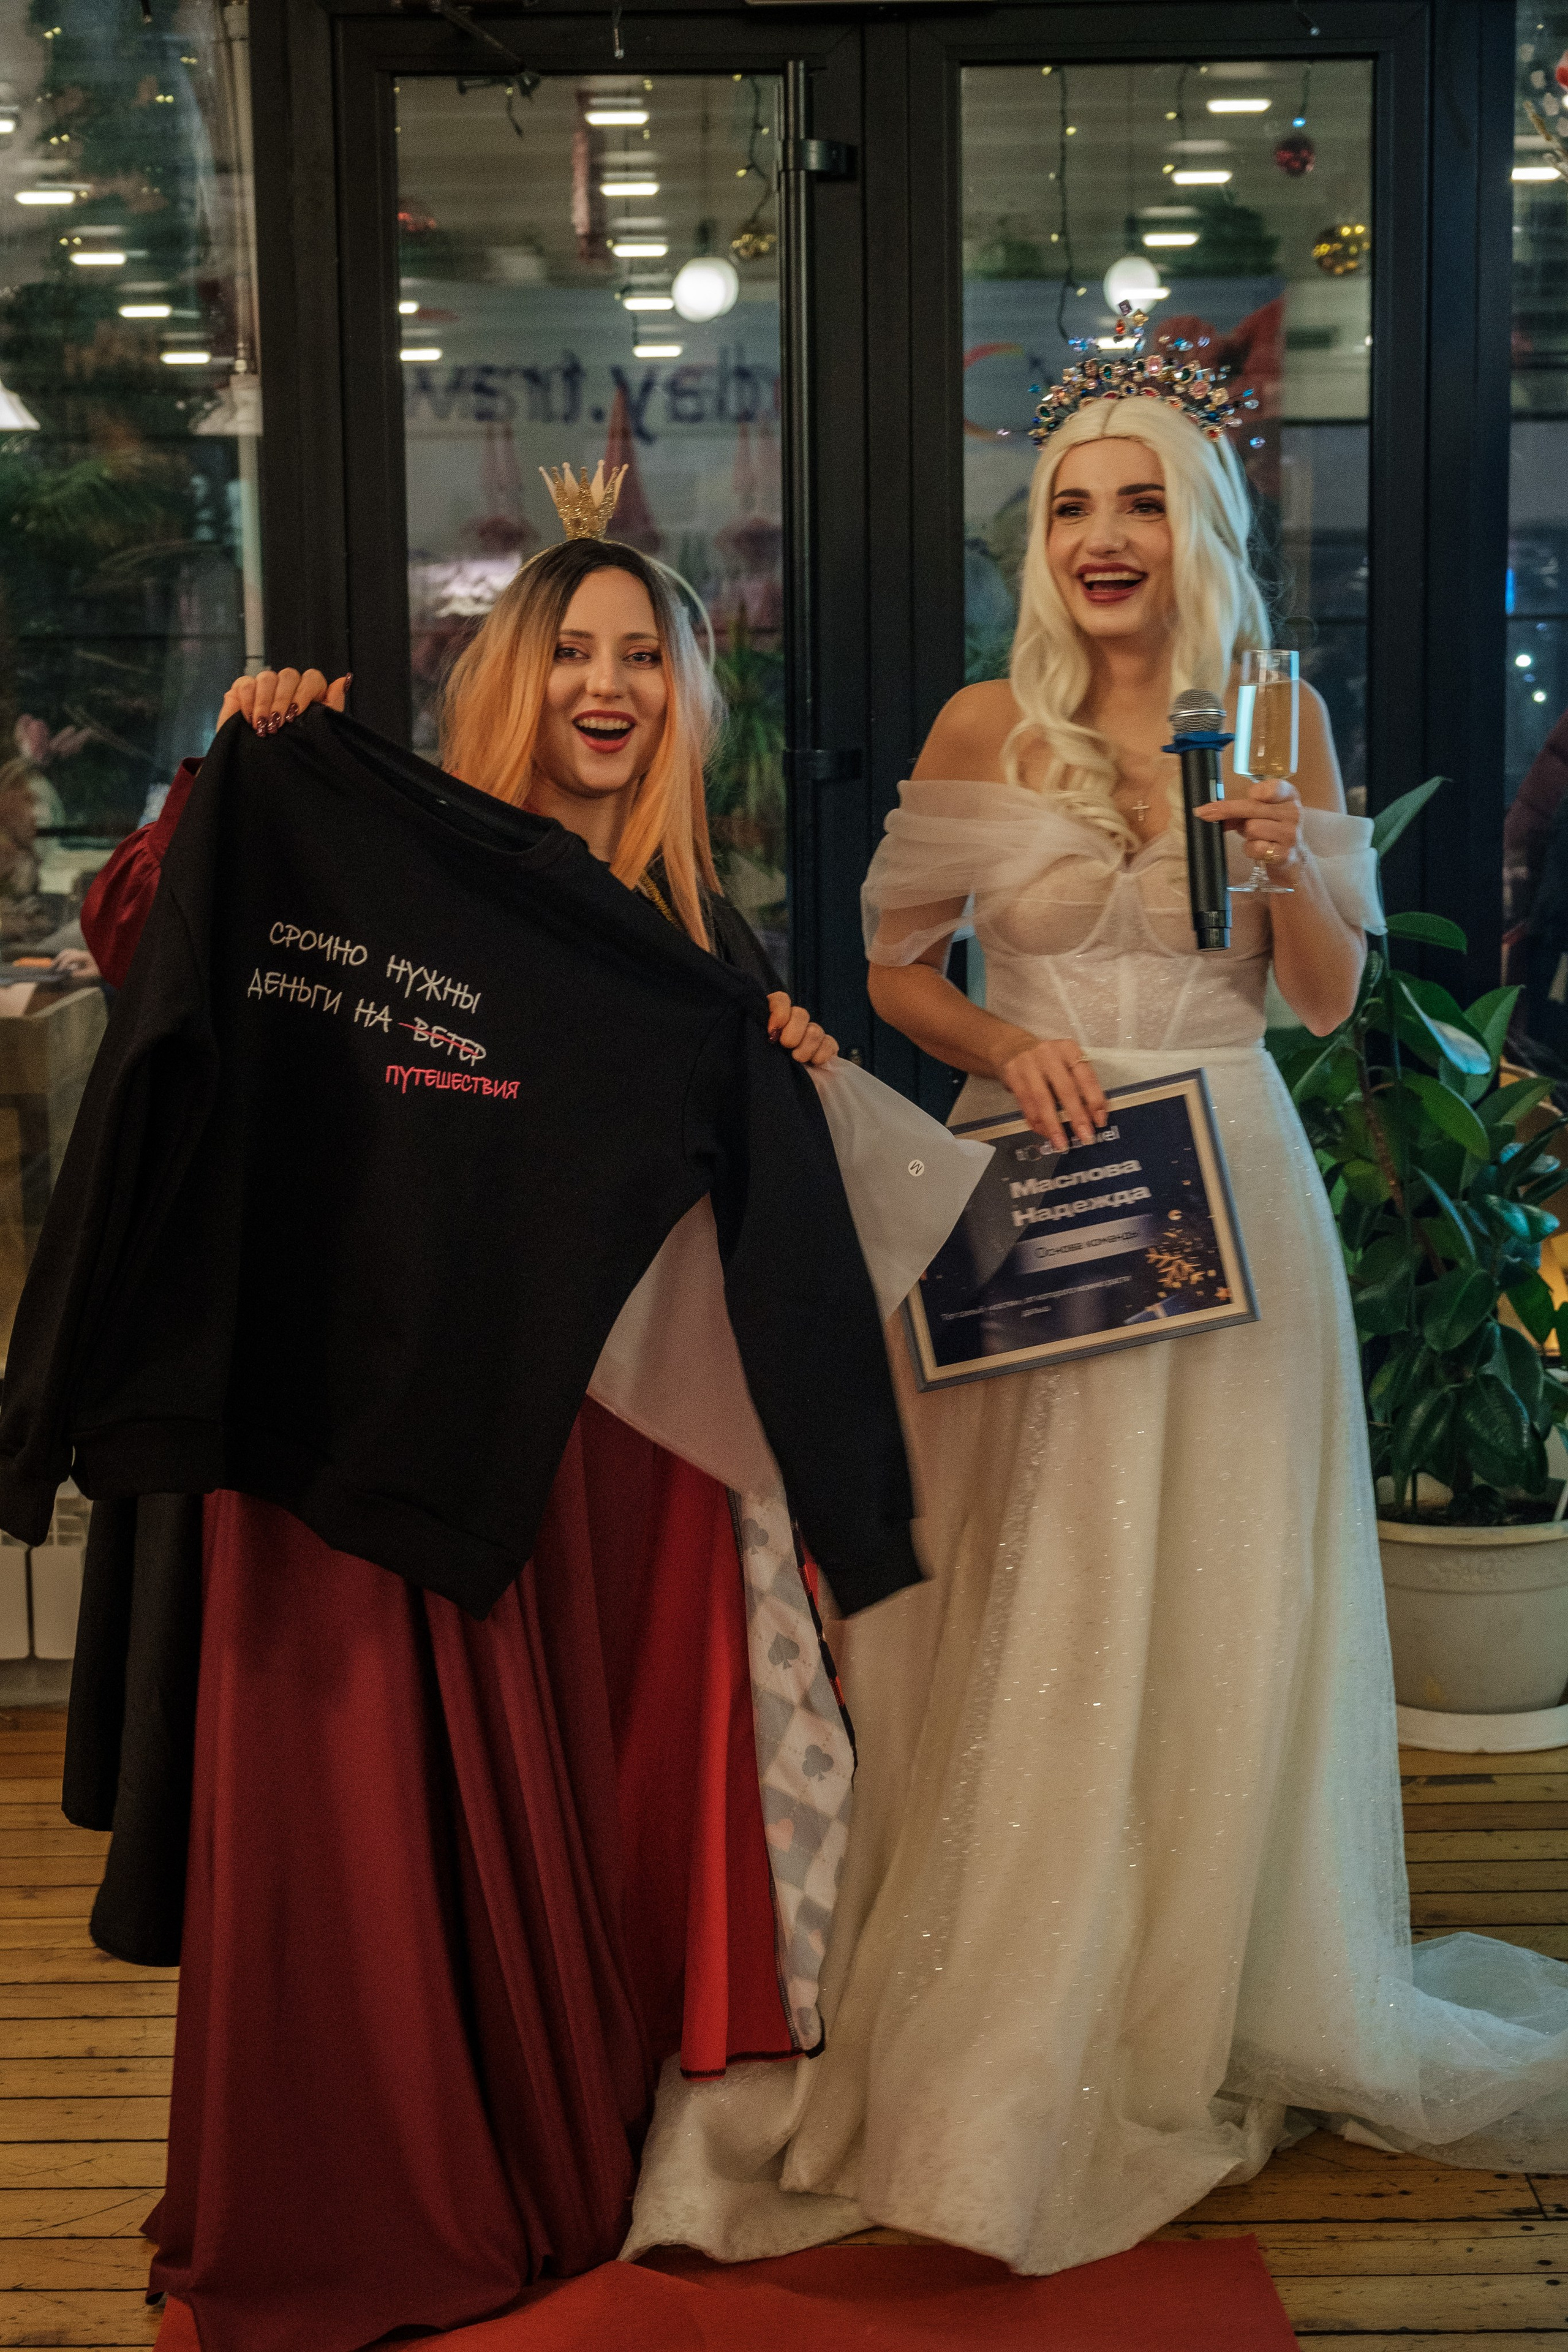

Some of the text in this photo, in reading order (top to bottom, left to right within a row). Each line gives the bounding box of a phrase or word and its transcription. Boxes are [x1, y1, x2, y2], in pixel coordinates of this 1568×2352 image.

[270, 922, 481, 1014] СРОЧНО НУЖНЫ
[247, 968, 487, 1066] ДЕНЬГИ НА ВЕТЕР
[385, 1065, 521, 1099] ПУТЕШЕСТВИЯ
[1009, 1159, 1143, 1199] Маслова
[1012, 1186, 1153, 1226] Надежда
